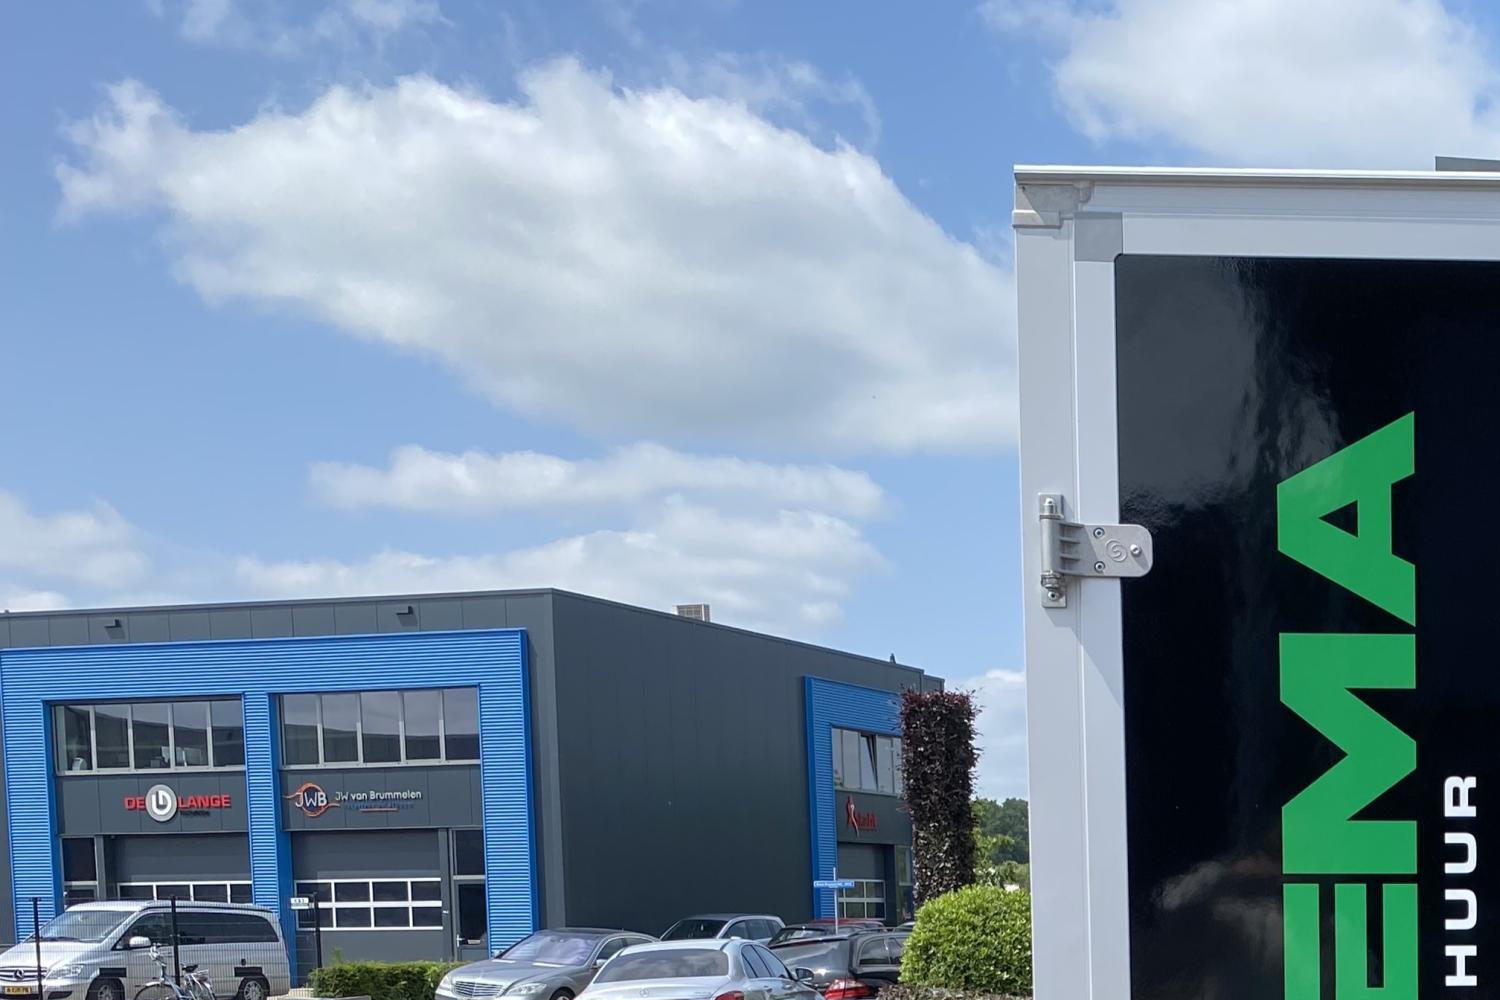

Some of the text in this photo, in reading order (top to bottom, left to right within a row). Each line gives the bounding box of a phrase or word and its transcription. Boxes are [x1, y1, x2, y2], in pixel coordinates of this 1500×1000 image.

[123, 794, 232, 811] DE LANGE
[295, 791, 328, 808] JWB
[351, 792, 368, 800] van
